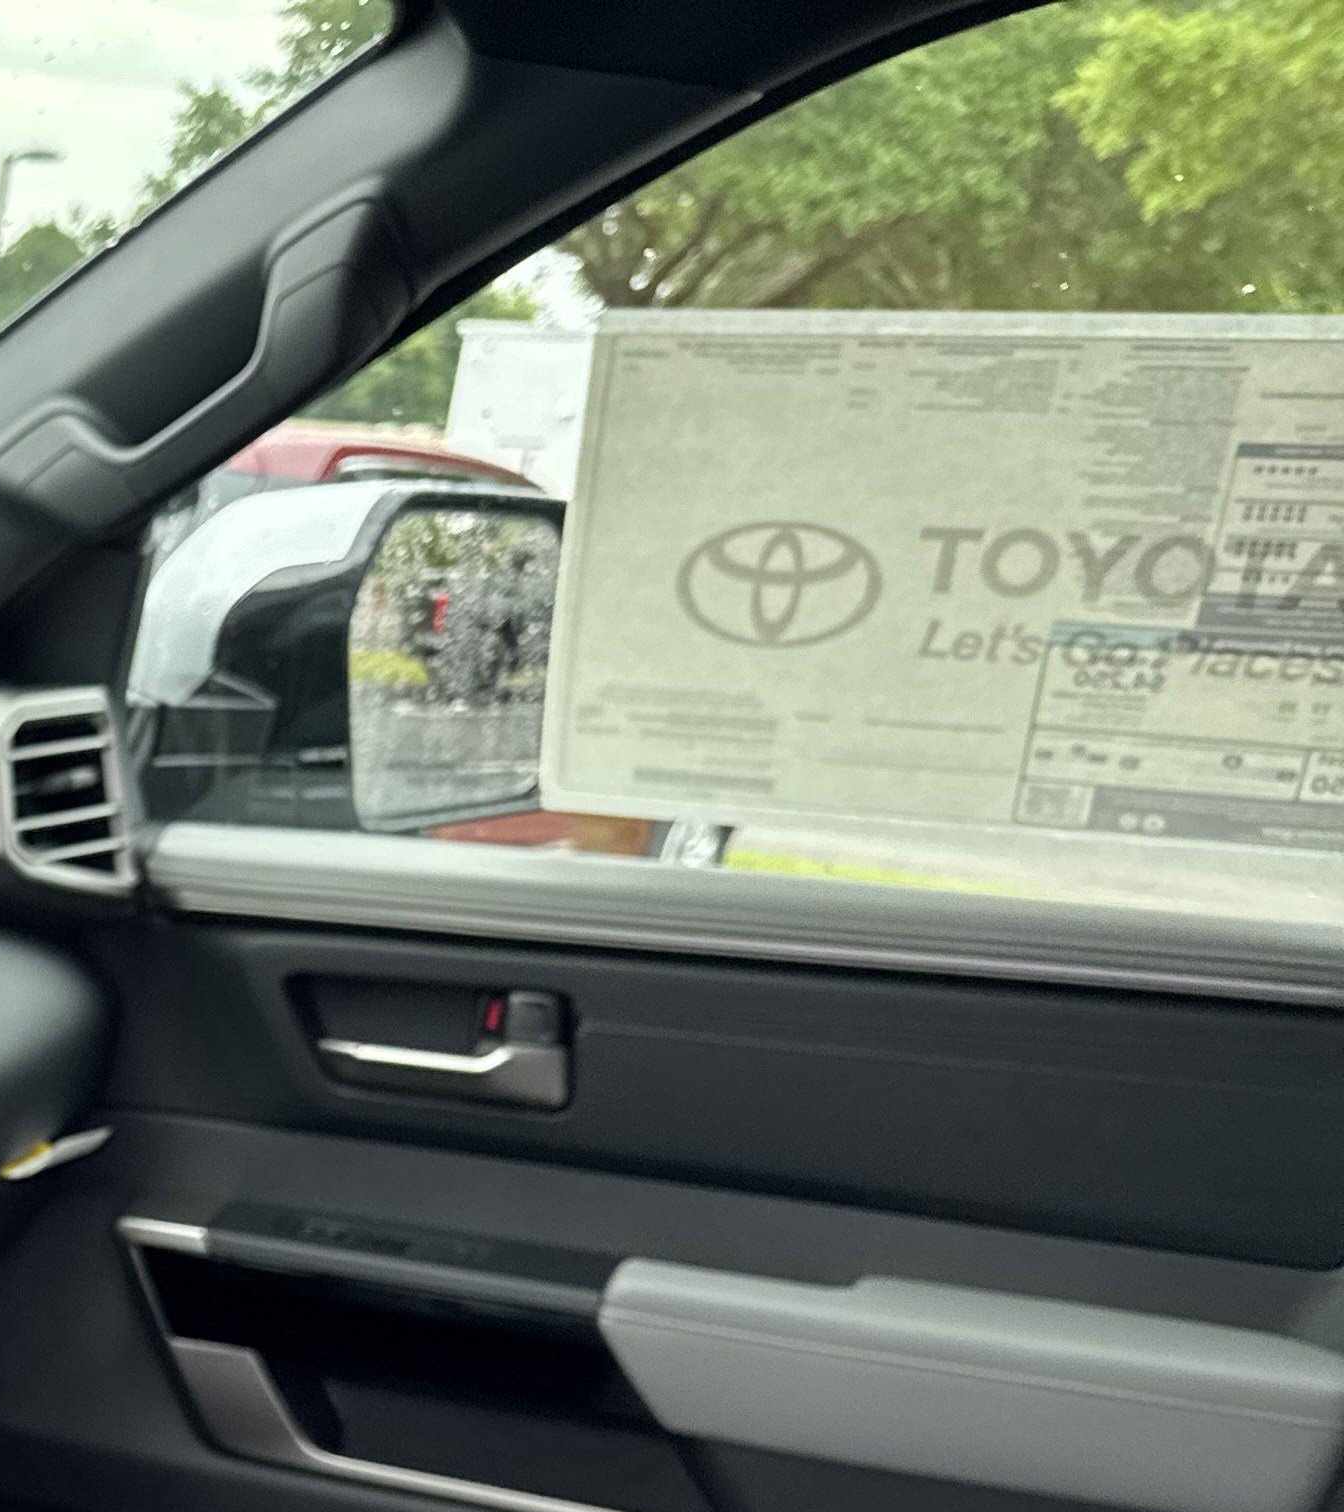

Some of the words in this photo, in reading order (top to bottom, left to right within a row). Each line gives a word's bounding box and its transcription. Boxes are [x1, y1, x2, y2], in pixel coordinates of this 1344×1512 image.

[919, 526, 1344, 612] TOYOTA
[917, 617, 1044, 666] Let's
[1060, 630, 1140, 671] Go
